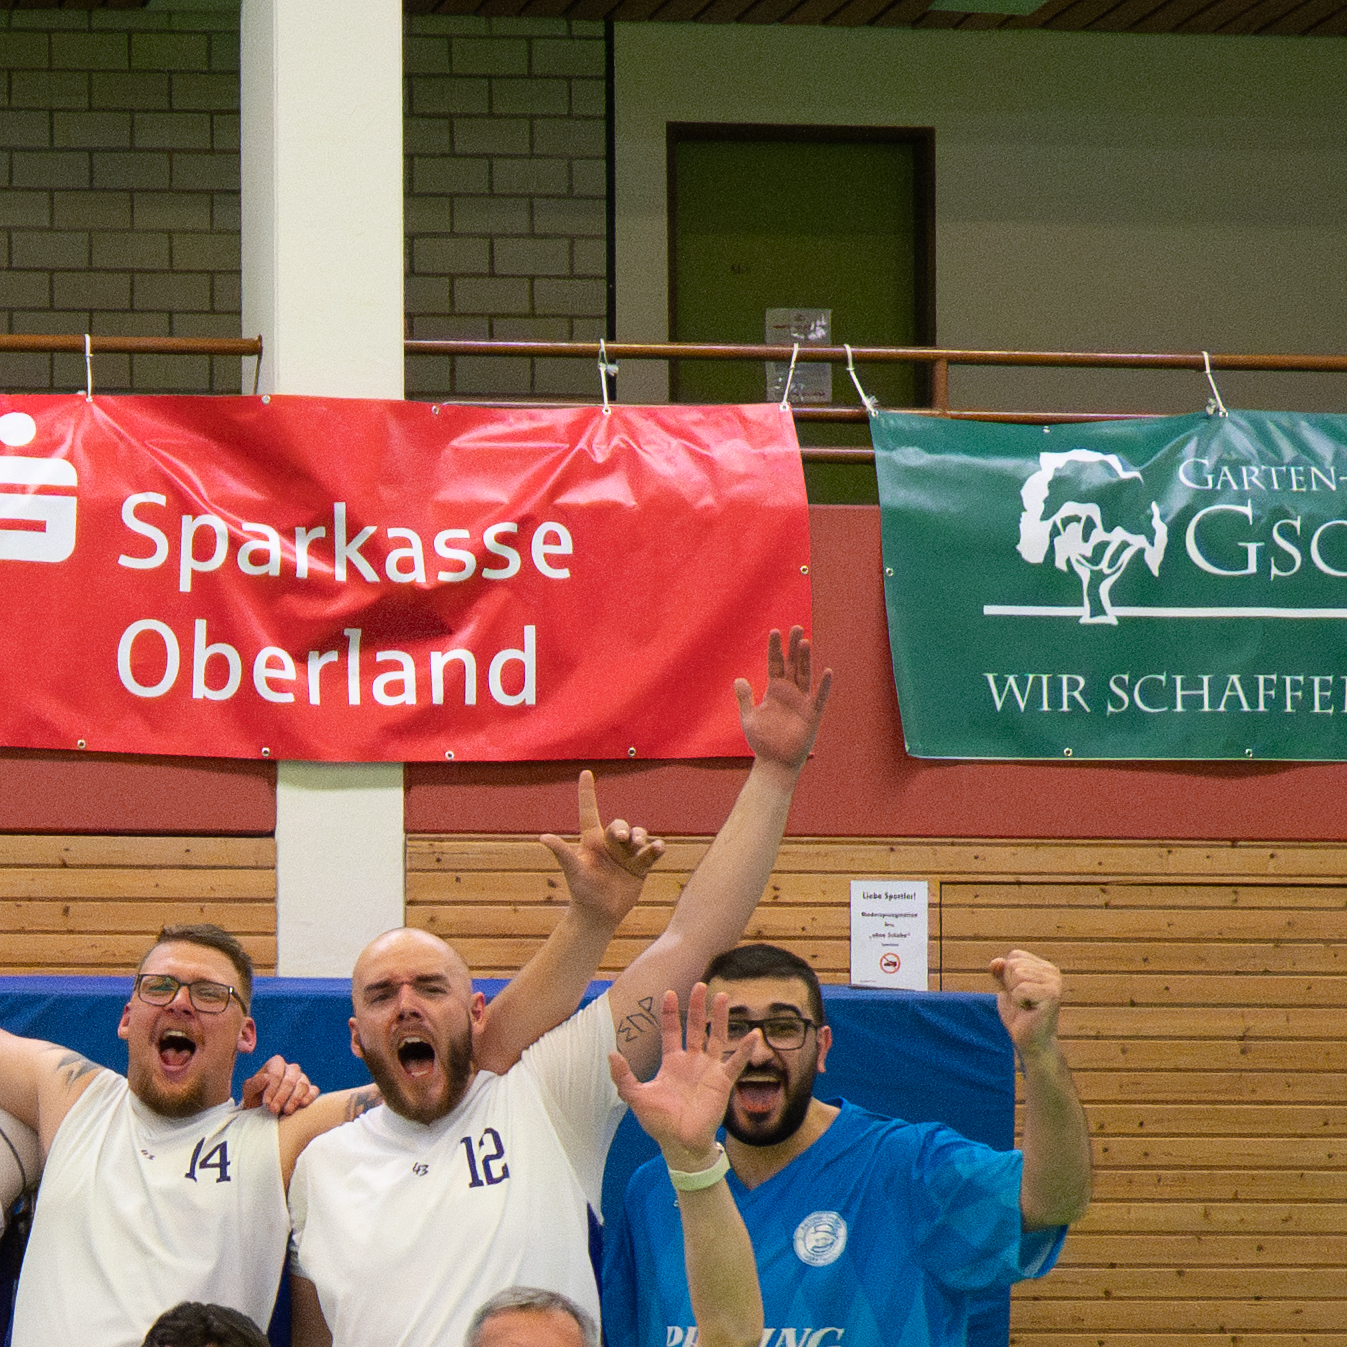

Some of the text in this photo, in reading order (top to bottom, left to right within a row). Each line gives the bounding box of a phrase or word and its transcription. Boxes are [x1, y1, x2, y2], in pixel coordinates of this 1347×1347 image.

[116, 491, 575, 593] Sparkasse
[116, 617, 538, 707] Oberland
[982, 671, 1347, 718] WIR SCHAFFE
[184, 1136, 232, 1183] 14
[459, 1127, 511, 1189] 12
